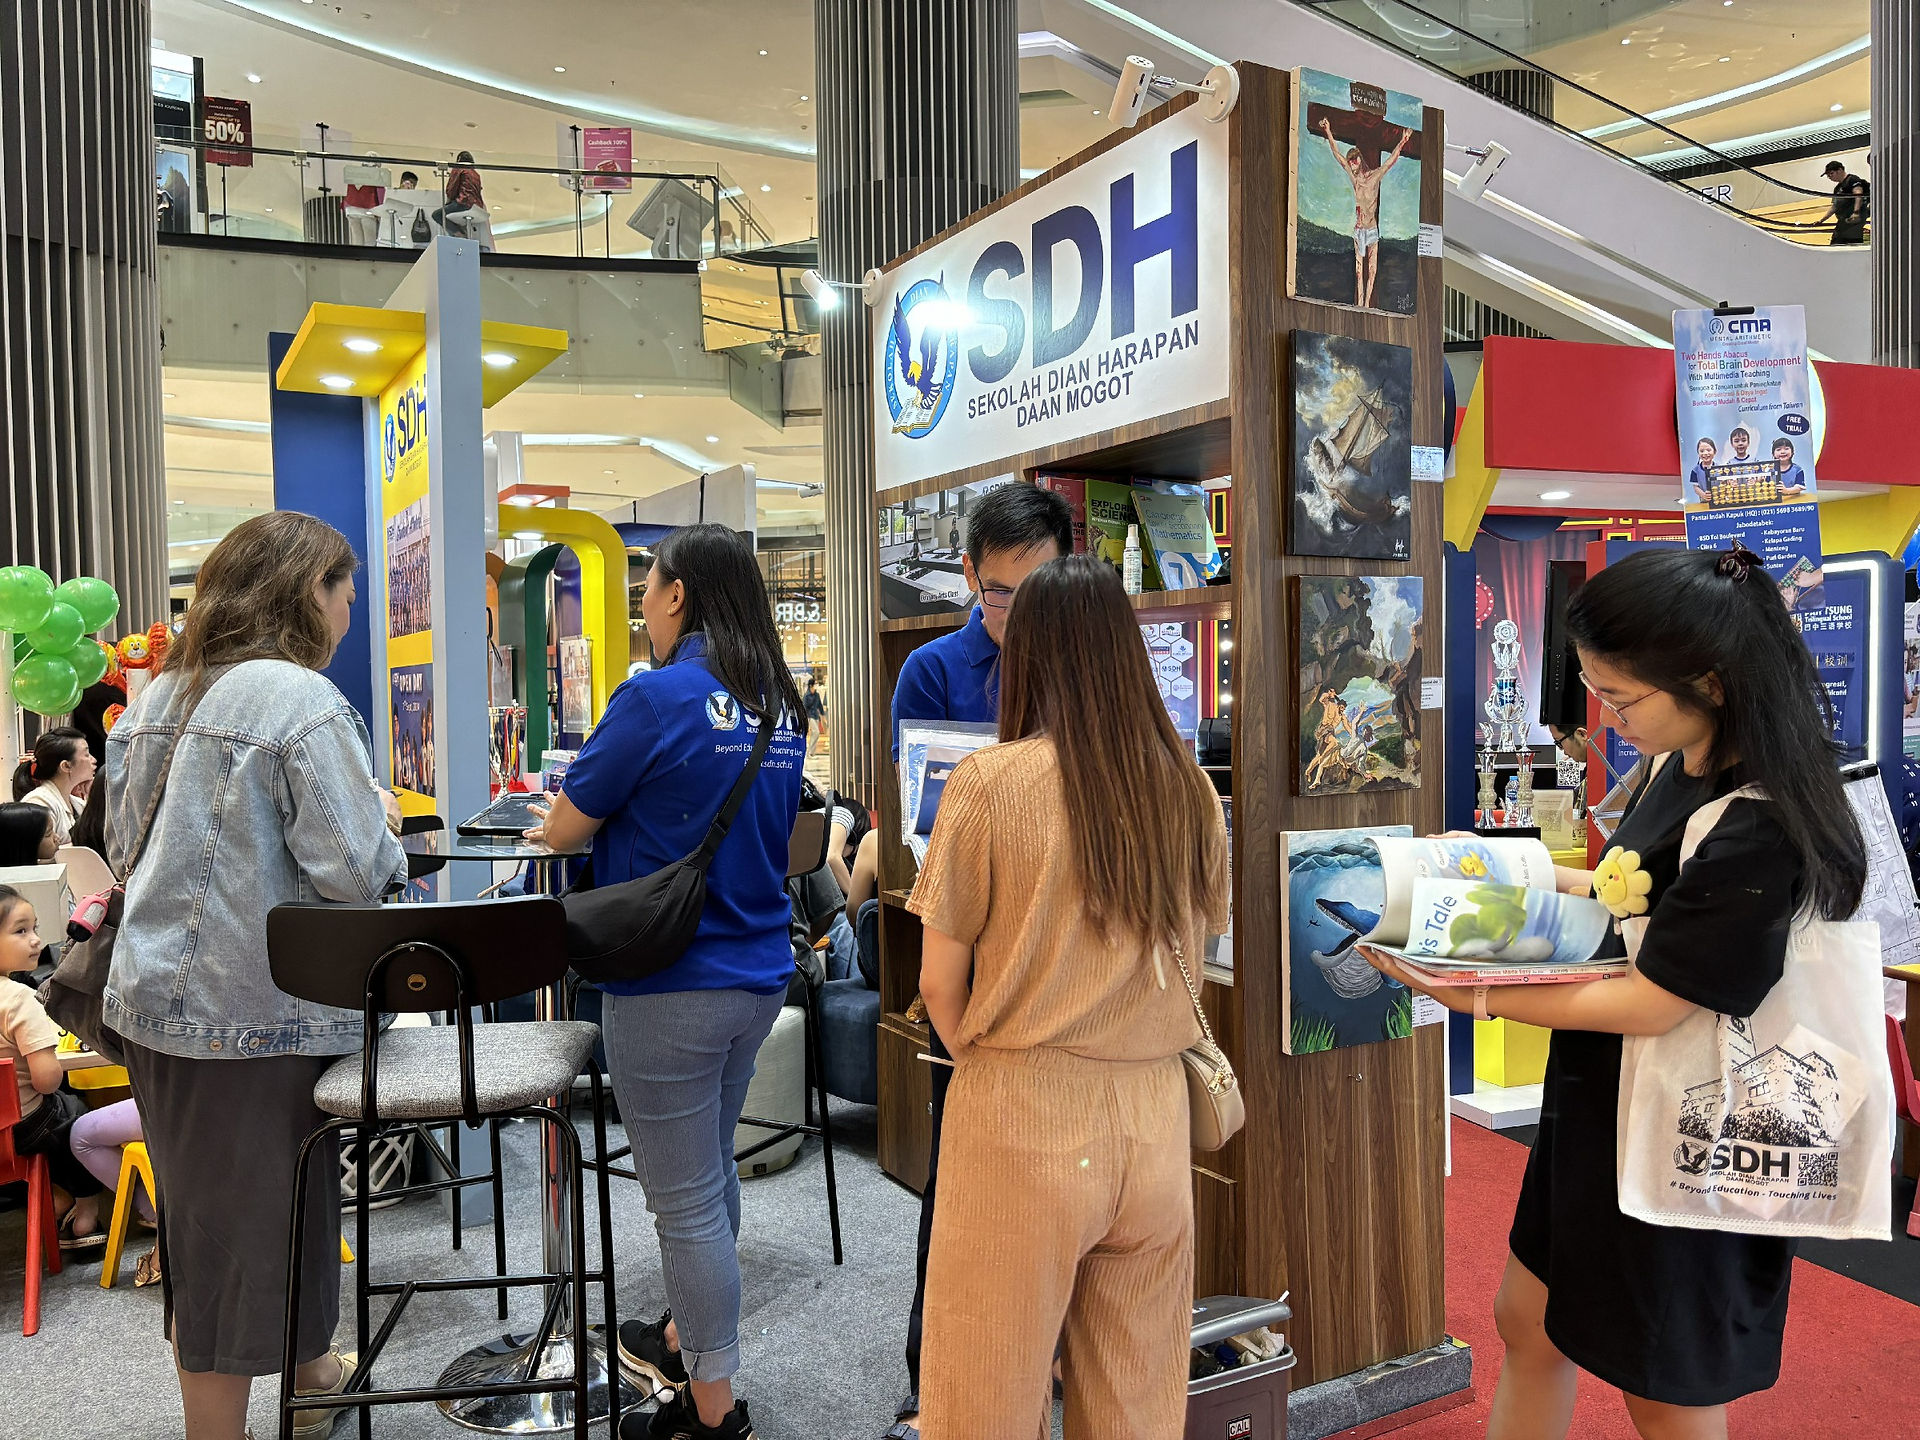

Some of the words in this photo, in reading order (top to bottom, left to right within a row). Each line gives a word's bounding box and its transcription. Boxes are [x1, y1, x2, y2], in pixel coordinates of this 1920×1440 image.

[205, 119, 244, 144] 50%
[967, 139, 1198, 384] SDH
[1728, 318, 1771, 334] CMA
[1681, 352, 1696, 360] Two
[1697, 351, 1721, 360] Hands
[1723, 350, 1748, 358] Abacus
[968, 373, 1041, 420] SEKOLAH
[1048, 357, 1090, 393] DIAN
[1097, 320, 1199, 375] HARAPAN
[1688, 362, 1697, 371] for
[1697, 360, 1718, 370] Total
[1719, 360, 1743, 369] Brain
[1743, 355, 1801, 369] Development
[1688, 373, 1703, 381] With
[1704, 370, 1739, 380] Multimedia
[1740, 369, 1771, 379] Teaching
[1017, 393, 1061, 428] DAAN
[1066, 371, 1134, 413] MOGOT
[1738, 404, 1768, 412] Curriculum
[1783, 401, 1803, 409] Taiwan
[397, 373, 428, 458] SDH
[1786, 415, 1802, 424] FREE
[1785, 424, 1803, 433] TRIAL
[1091, 499, 1138, 513] EXPLORIN
[1091, 508, 1138, 523] SCIENC
[1711, 512, 1726, 520] Indah
[1726, 510, 1744, 519] Kapuk
[1761, 508, 1776, 516] (021)
[1736, 520, 1774, 529] Jabodetabek:
[1151, 527, 1203, 541] Mathematics
[1719, 532, 1746, 540] Boulevard
[1763, 528, 1792, 536] Kebayoran
[1764, 537, 1783, 545] Kelapa
[1783, 535, 1802, 543] Gading
[1804, 614, 1832, 623] Trilingual
[1832, 613, 1853, 621] School
[715, 742, 743, 754] Beyond
[768, 745, 794, 757] Touching
[1424, 895, 1457, 932] Tale
[1711, 1143, 1790, 1178] SDH
[1726, 1175, 1744, 1184] DAAN
[1745, 1178, 1769, 1187] MOGOT
[1738, 1172, 1755, 1180] DIAN
[1756, 1176, 1790, 1184] HARAPAN
[1669, 1180, 1677, 1188] #
[1678, 1182, 1712, 1195] Beyond
[1712, 1184, 1760, 1197] Education
[1768, 1190, 1810, 1201] Touching
[1812, 1191, 1837, 1201] Lives
[1230, 1421, 1249, 1435] CAL
